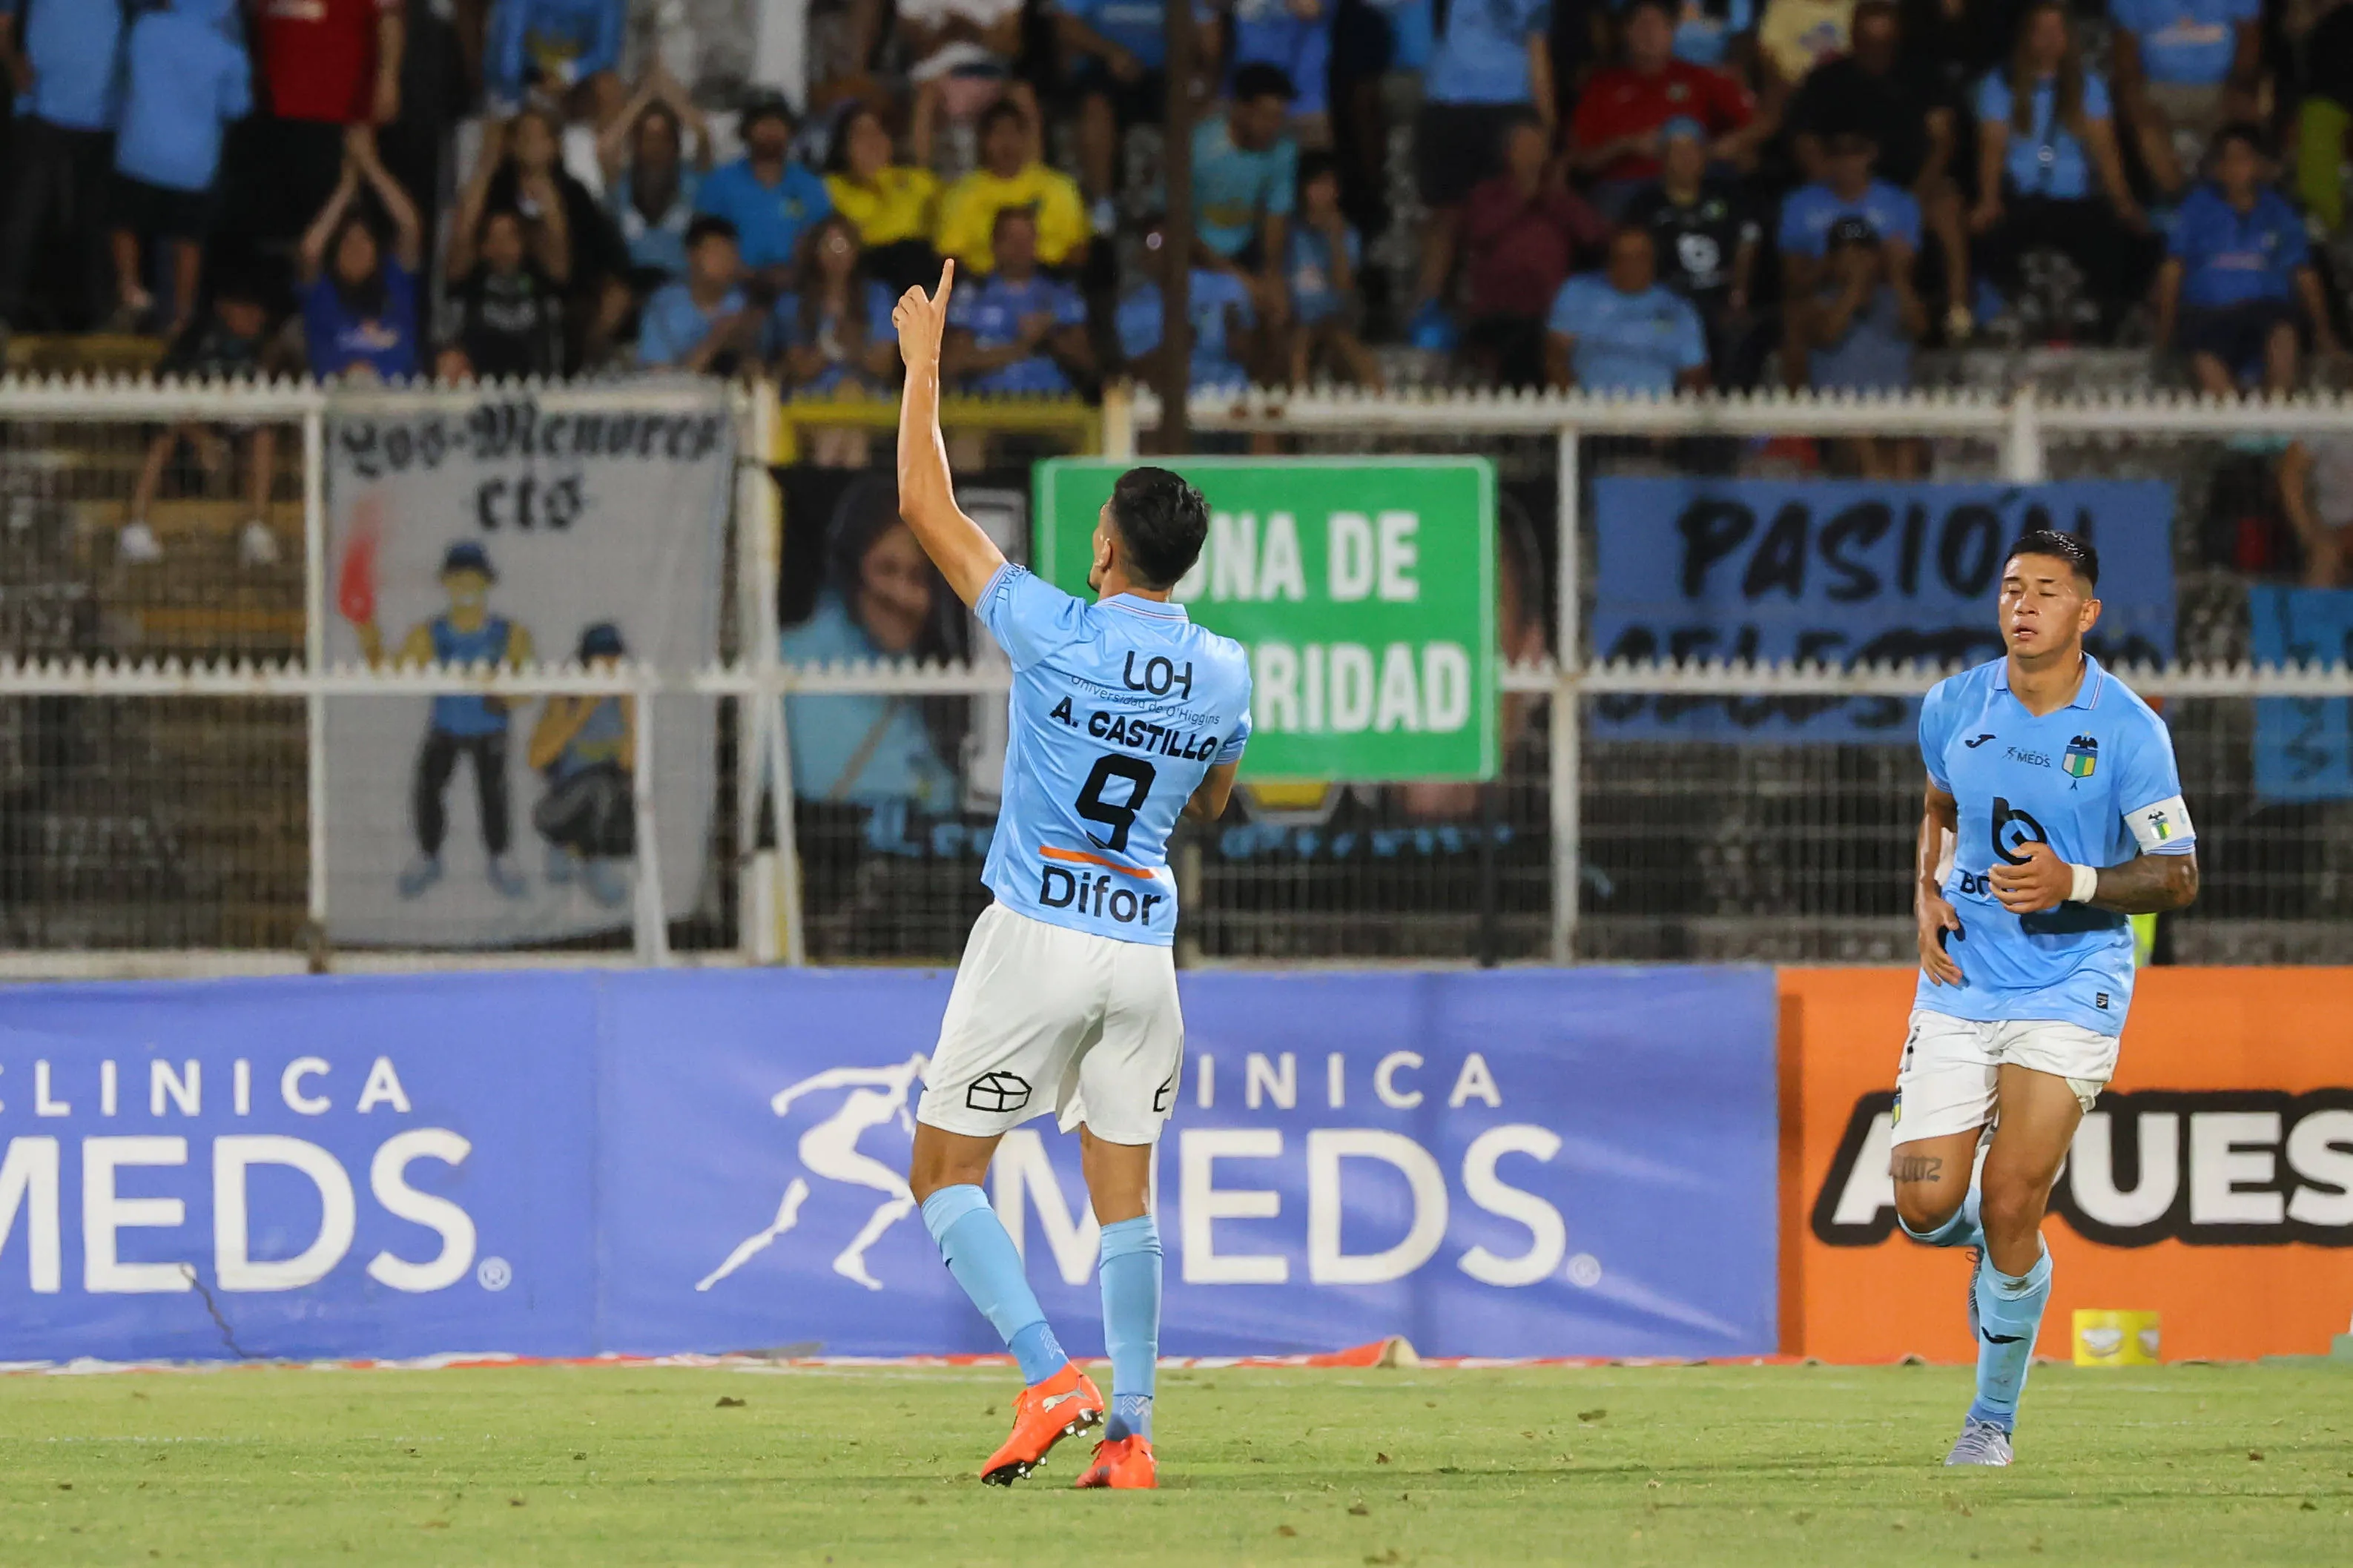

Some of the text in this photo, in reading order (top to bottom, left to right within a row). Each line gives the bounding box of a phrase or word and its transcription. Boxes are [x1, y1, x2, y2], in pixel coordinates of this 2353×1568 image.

[1170, 512, 1421, 603] NA DE
[1049, 695, 1218, 761] A. CASTILLO
[1149, 701, 1164, 714] de
[1166, 707, 1221, 725] O'Higgins
[2016, 752, 2051, 768] MEDS
[1075, 753, 1156, 853] 9
[1039, 864, 1161, 926] Difor
[0, 1056, 412, 1117] LINICA
[1198, 1050, 1503, 1109] INICA
